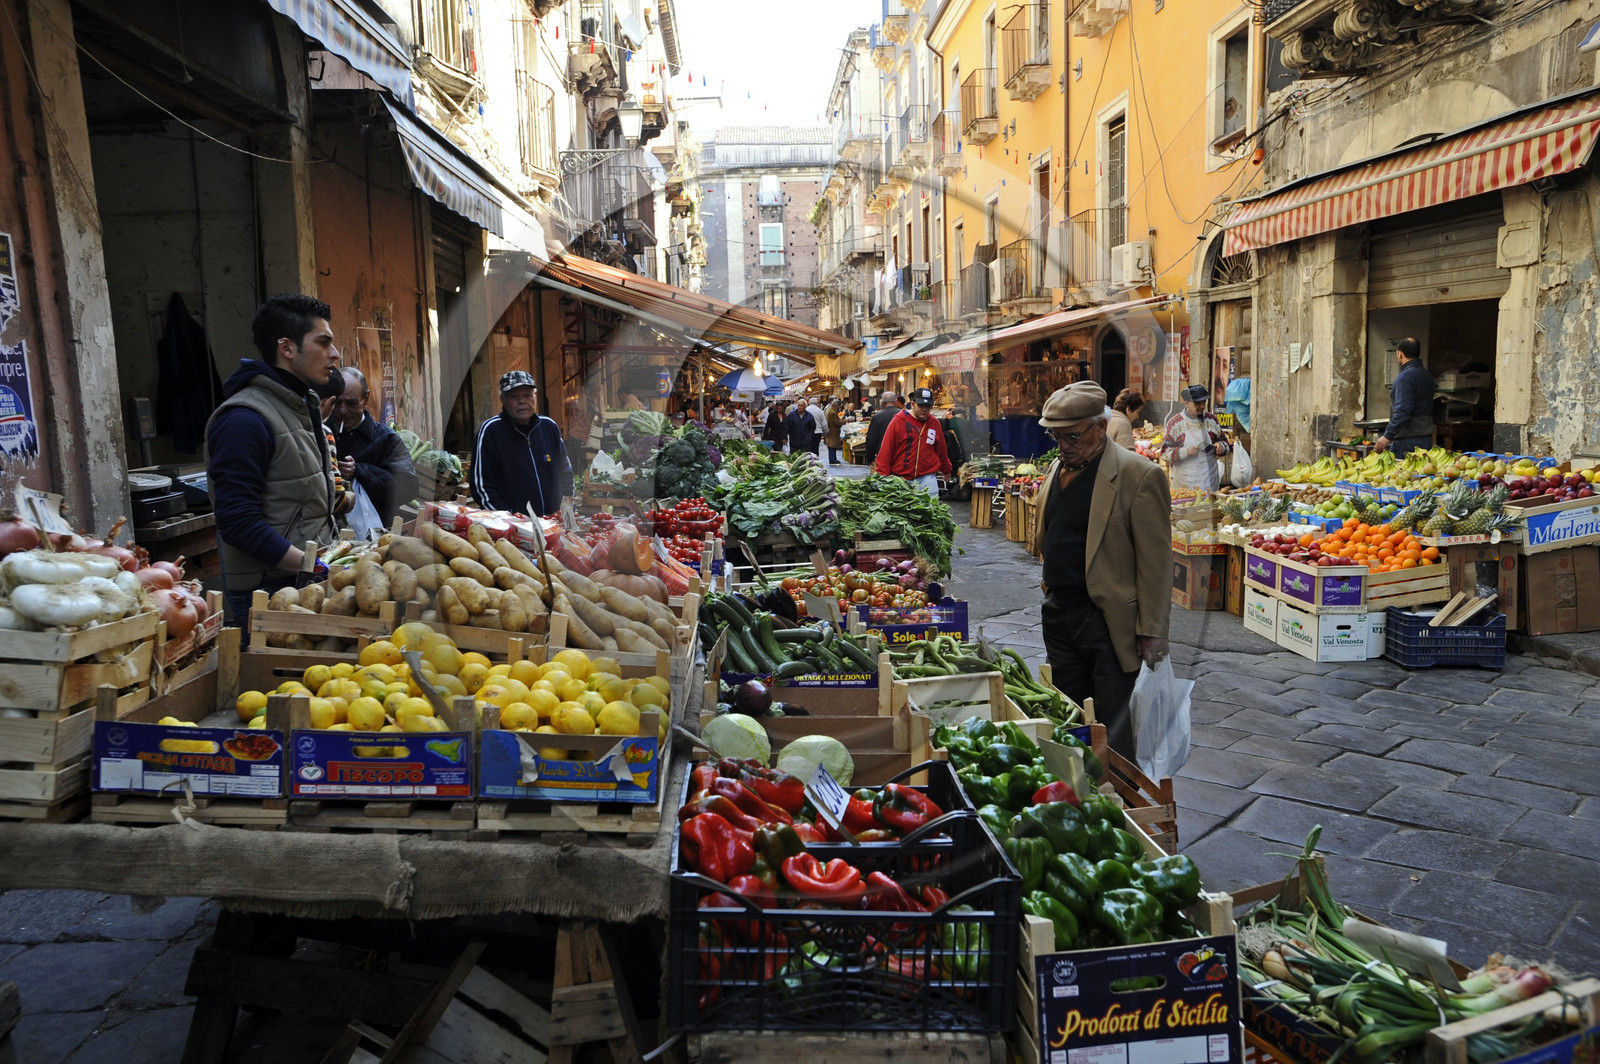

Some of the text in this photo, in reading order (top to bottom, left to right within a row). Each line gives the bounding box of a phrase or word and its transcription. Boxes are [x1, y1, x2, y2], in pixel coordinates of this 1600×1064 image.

[893, 631, 917, 642] Sole
[327, 760, 424, 783] PISCOPO
[1050, 993, 1228, 1048] Prodotti di Sicilia
